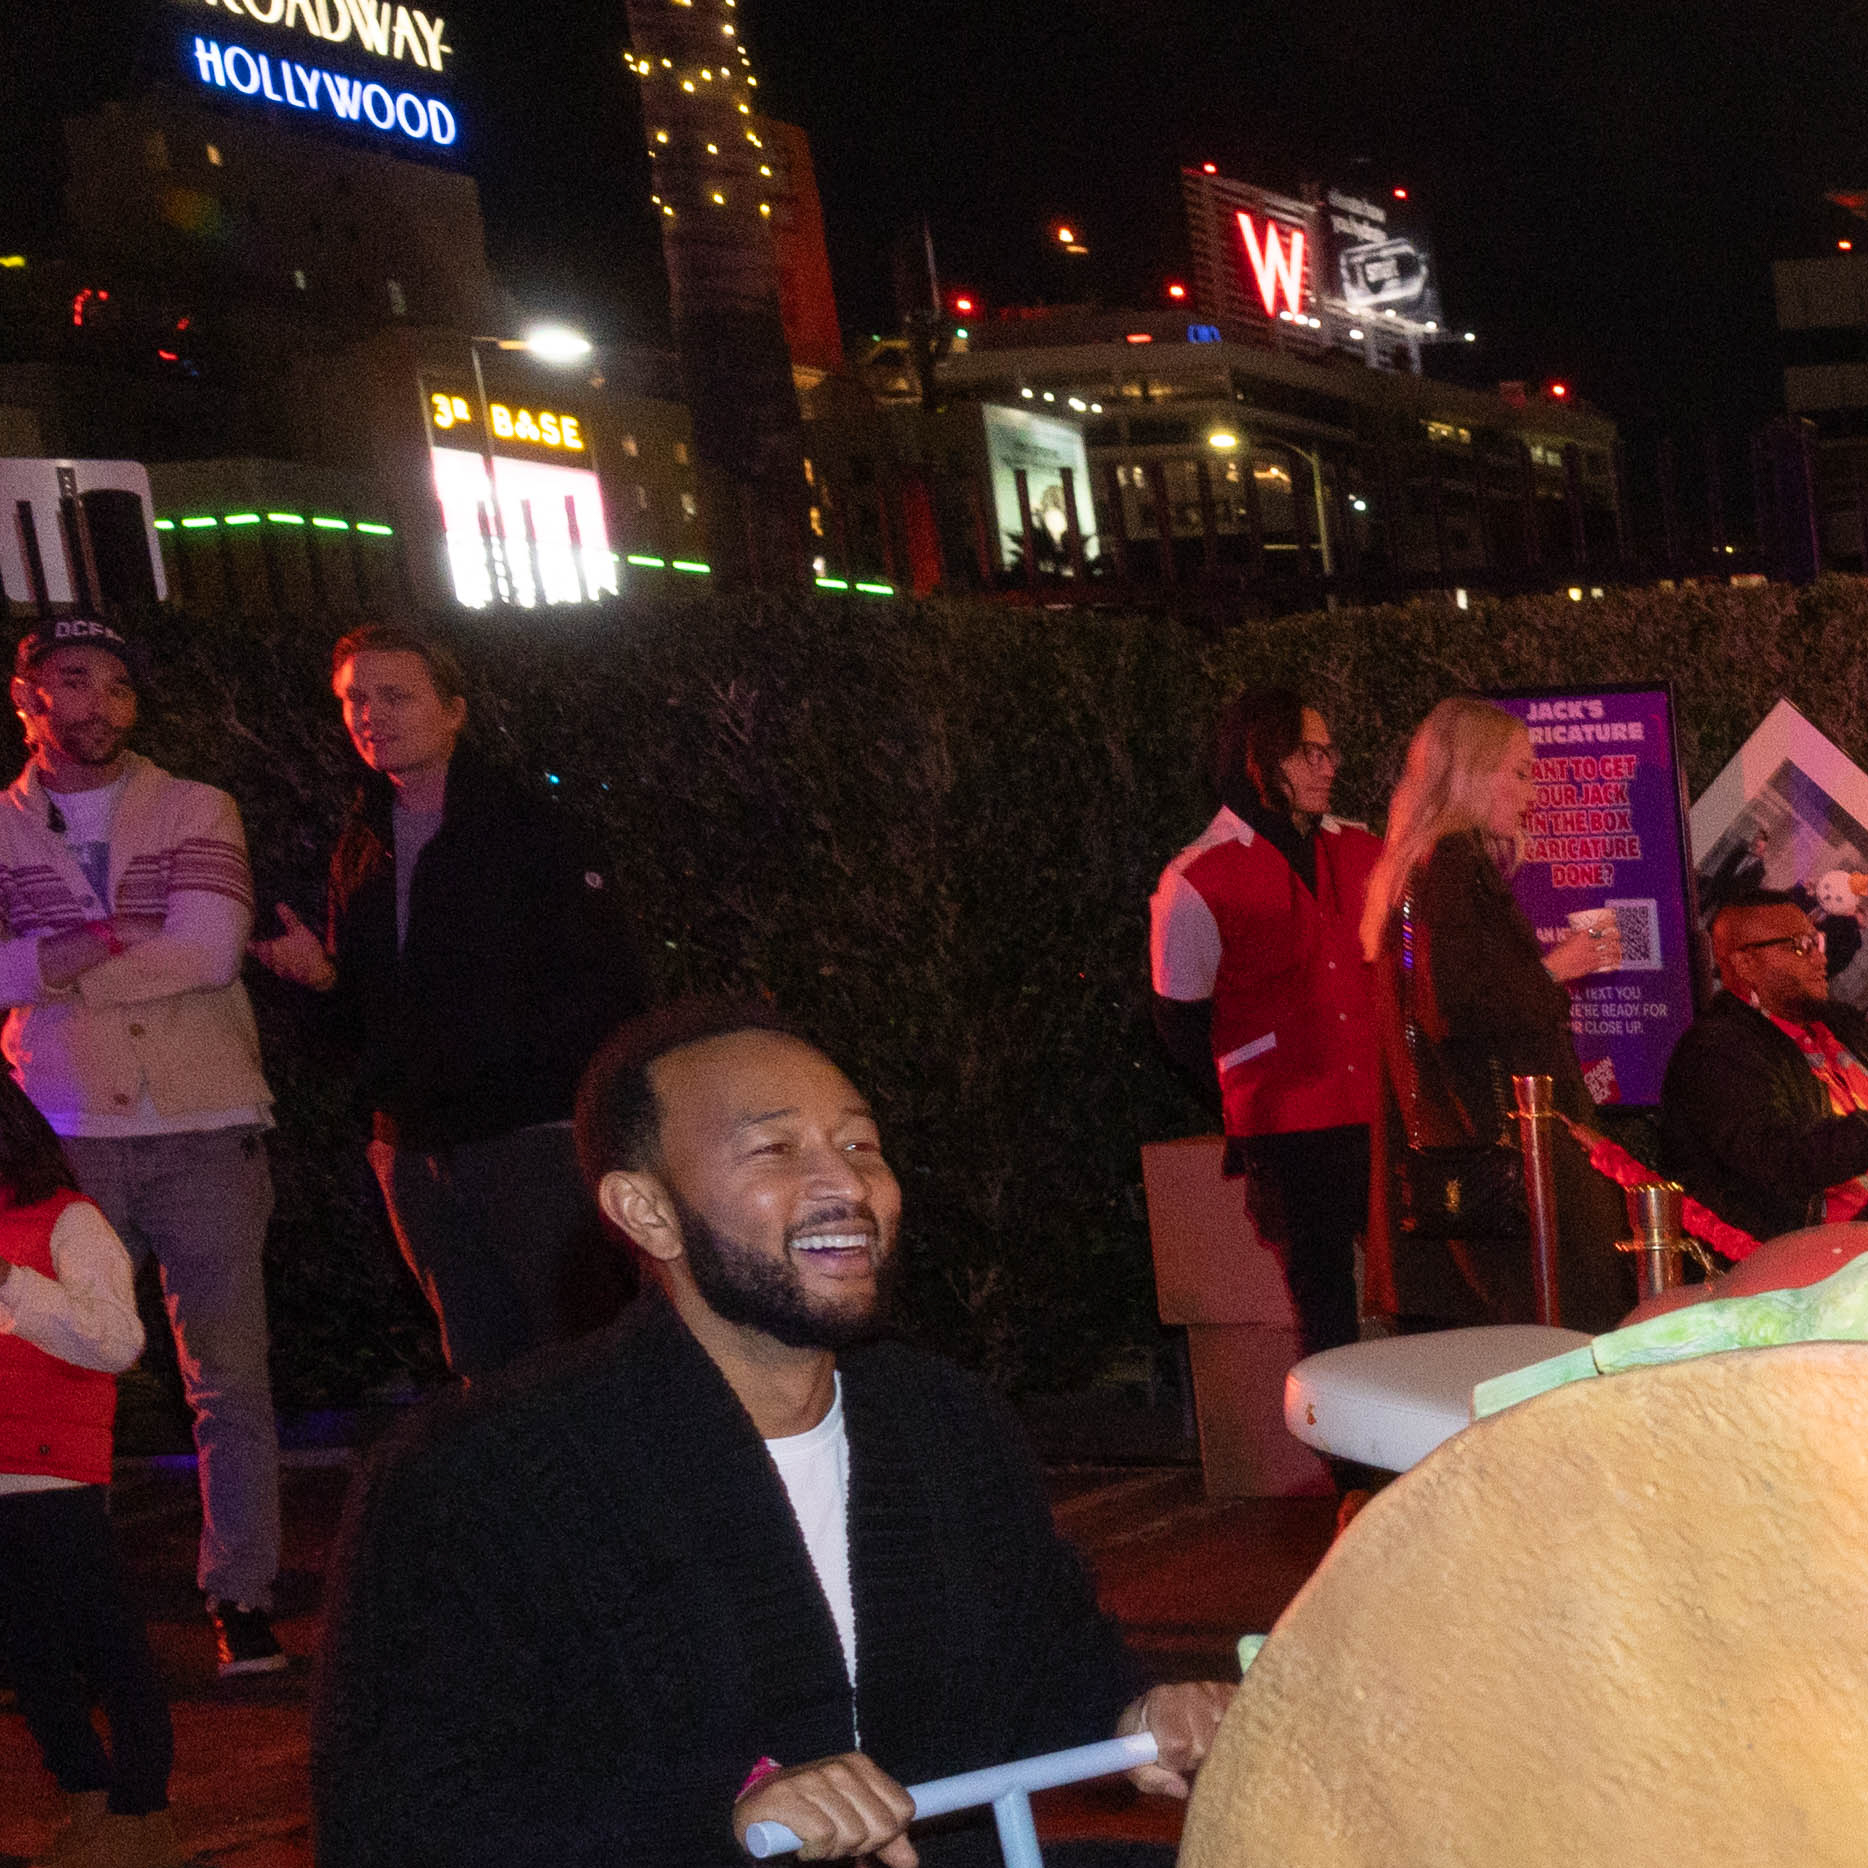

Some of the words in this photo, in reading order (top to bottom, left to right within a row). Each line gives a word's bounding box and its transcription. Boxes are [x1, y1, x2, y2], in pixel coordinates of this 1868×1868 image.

[194, 37, 456, 144] HOLLYWOOD
[1236, 210, 1305, 318] W
[1527, 699, 1605, 721] JACK'S
[1528, 722, 1645, 744] RICATURE
[1532, 756, 1569, 781] ANT
[1570, 756, 1597, 781] TO
[1600, 754, 1637, 780] GET
[1532, 783, 1577, 808] OUR
[1580, 781, 1631, 807] JACK
[1551, 810, 1588, 834] THE
[1589, 808, 1633, 833] BOX
[1552, 863, 1615, 888] DONE?
[1615, 986, 1641, 1000] YOU
[1602, 1003, 1639, 1017] READY
[1643, 1003, 1668, 1017] FOR
[1585, 1020, 1623, 1034] CLOSE
